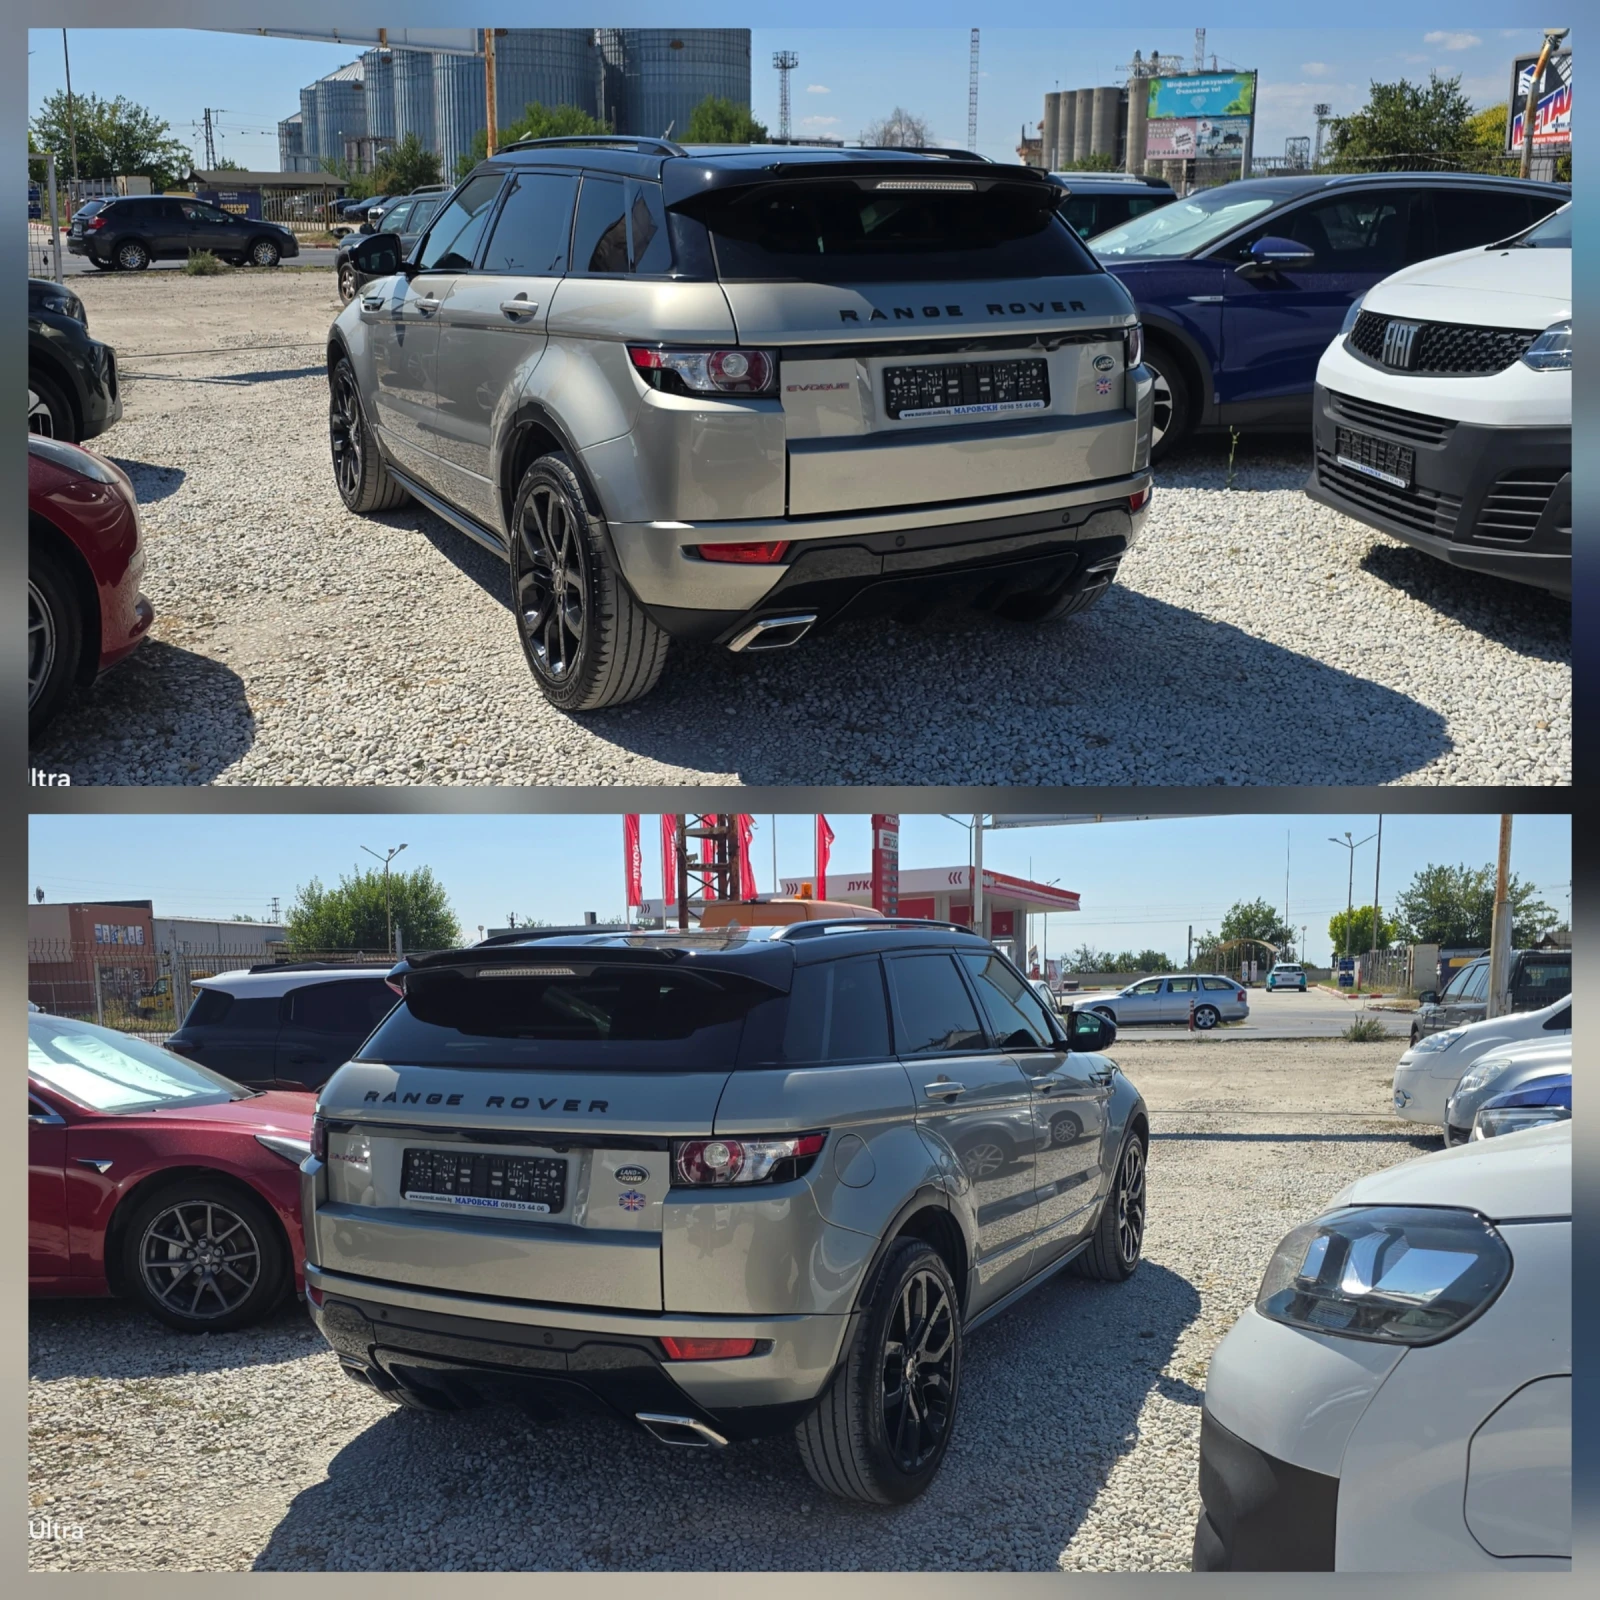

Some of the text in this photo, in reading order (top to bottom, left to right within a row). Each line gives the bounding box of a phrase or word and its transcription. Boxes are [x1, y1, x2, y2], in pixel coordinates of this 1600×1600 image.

[839, 300, 1087, 322] RANGE ROVER
[1382, 322, 1419, 367] FIAT
[786, 382, 850, 392] EVOQUE
[953, 404, 998, 415] МАРОВСКИ
[363, 1090, 609, 1113] RANGE ROVER
[455, 1196, 499, 1208] МАРОВСКИ
[500, 1201, 516, 1209] 0898
